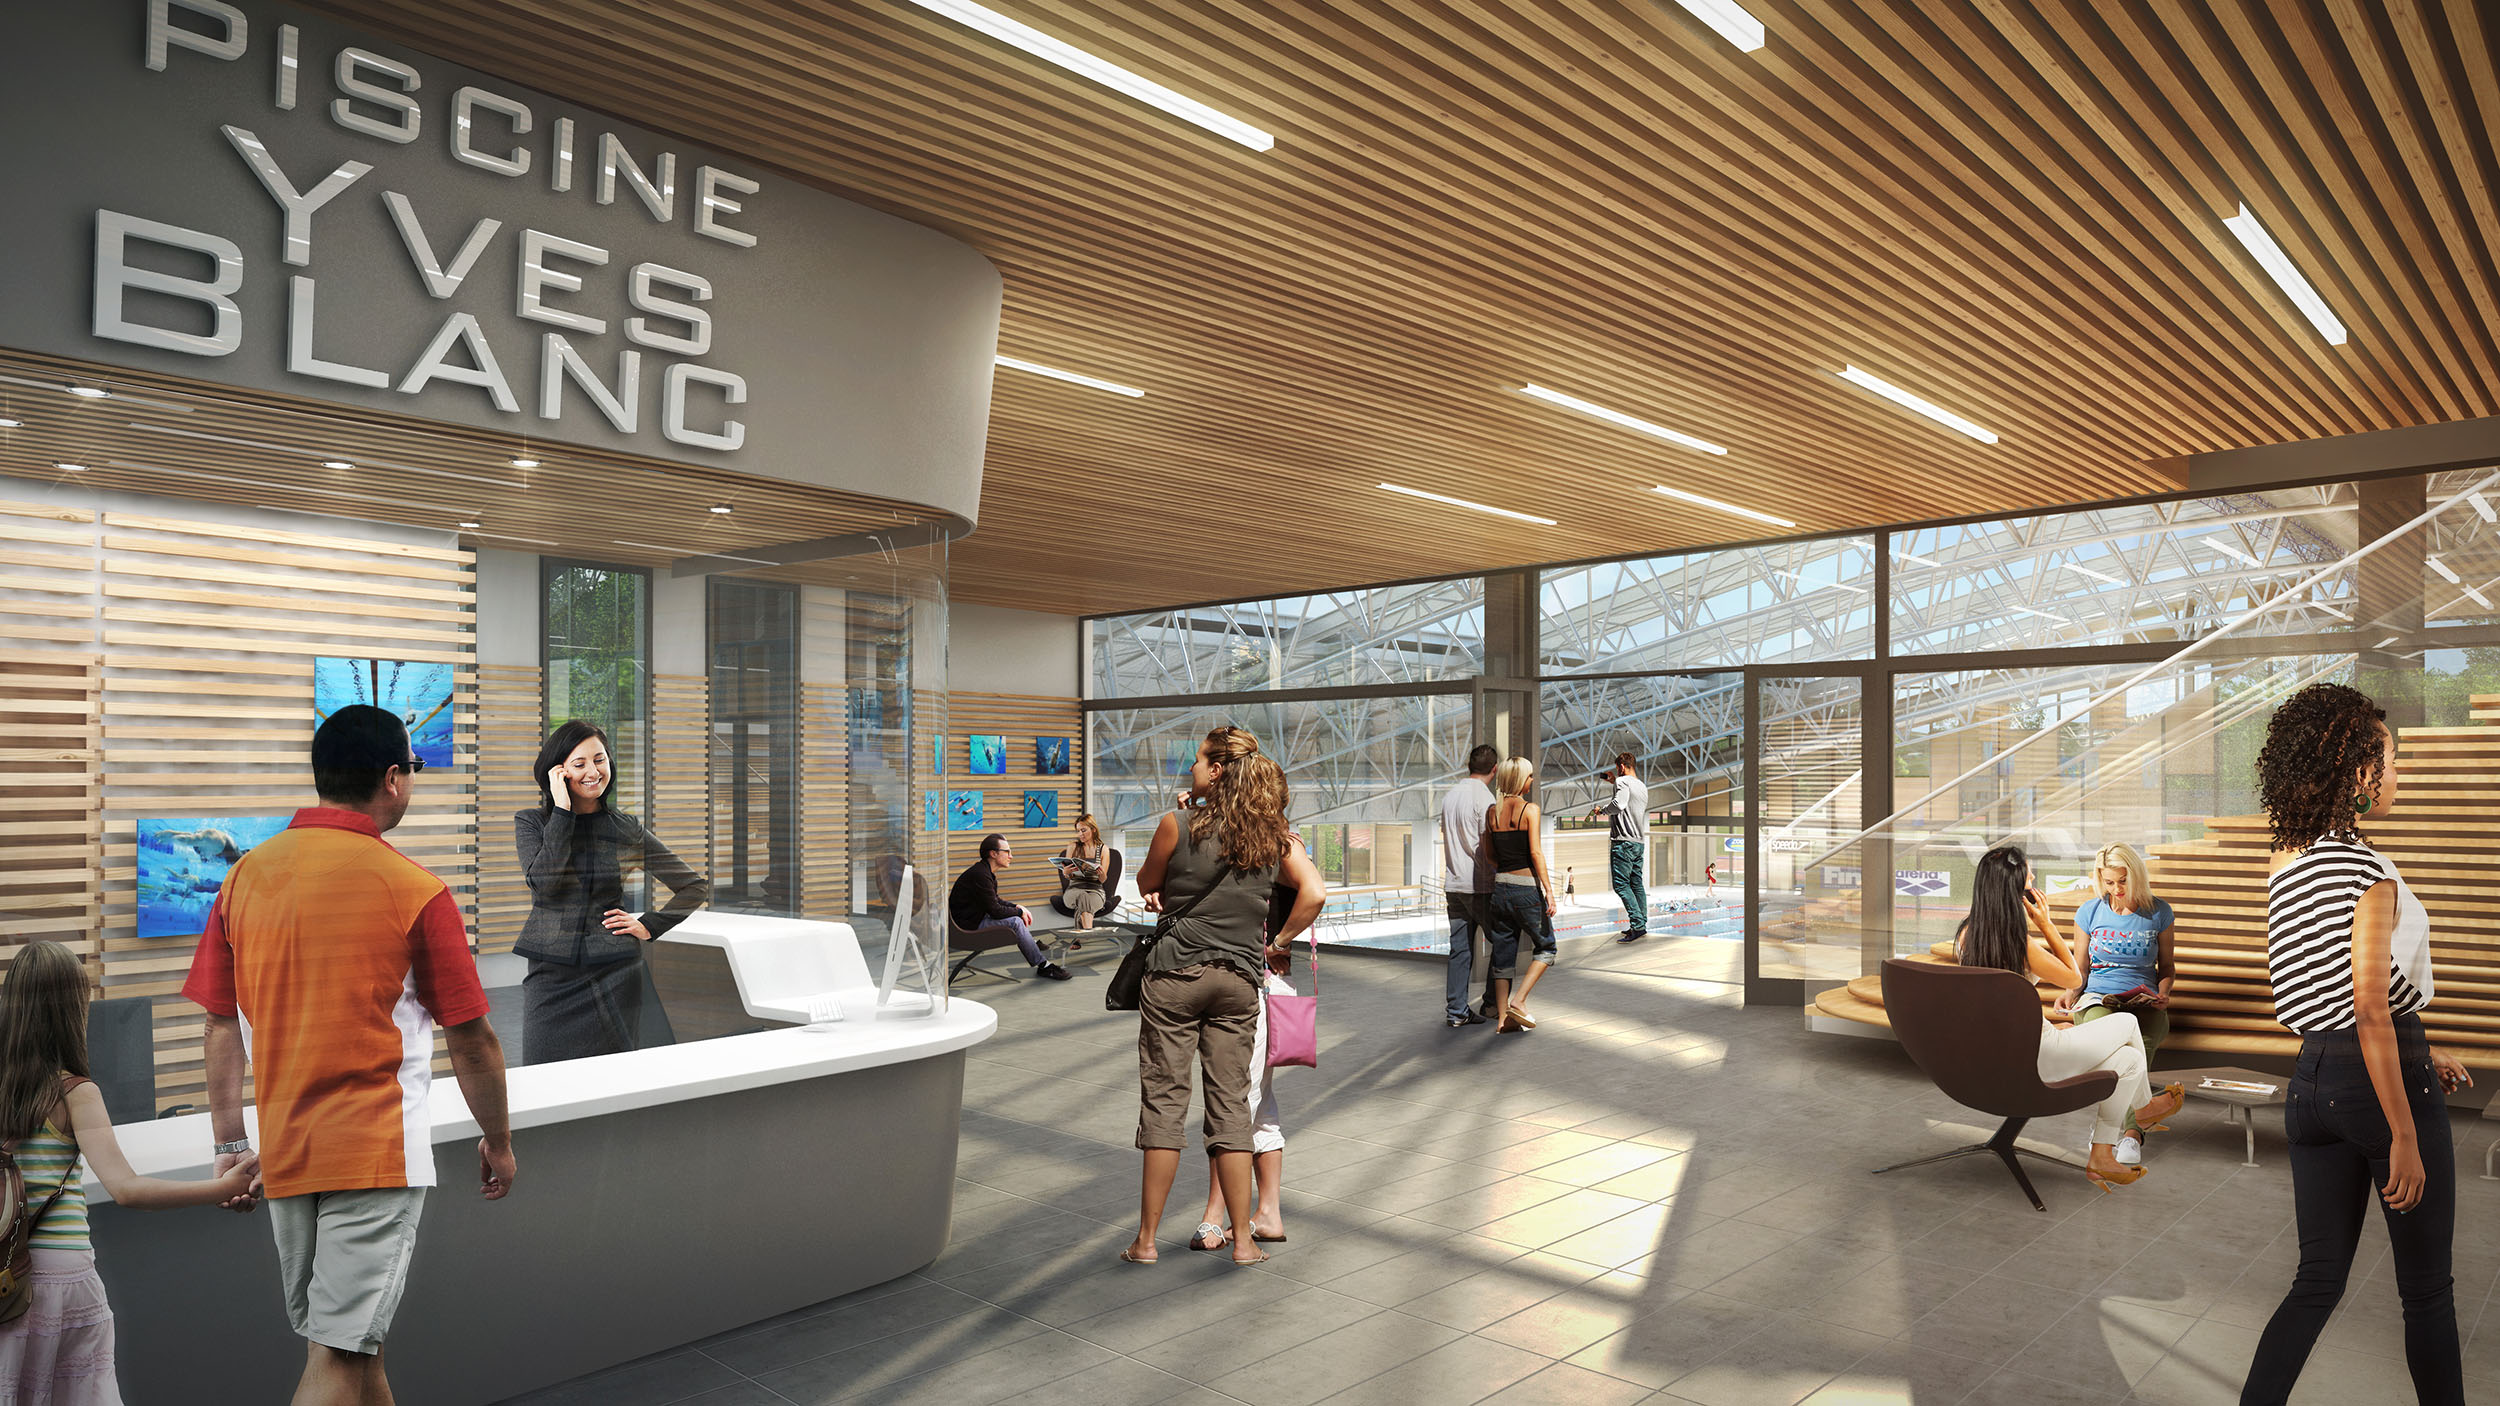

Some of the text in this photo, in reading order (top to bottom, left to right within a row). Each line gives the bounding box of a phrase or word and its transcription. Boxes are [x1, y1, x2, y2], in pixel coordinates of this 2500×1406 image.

[145, 0, 760, 248] PISCINE
[220, 124, 714, 356] YVES
[92, 208, 748, 452] BLANC
[1772, 839, 1799, 852] speedo
[1896, 869, 1939, 880] arena
